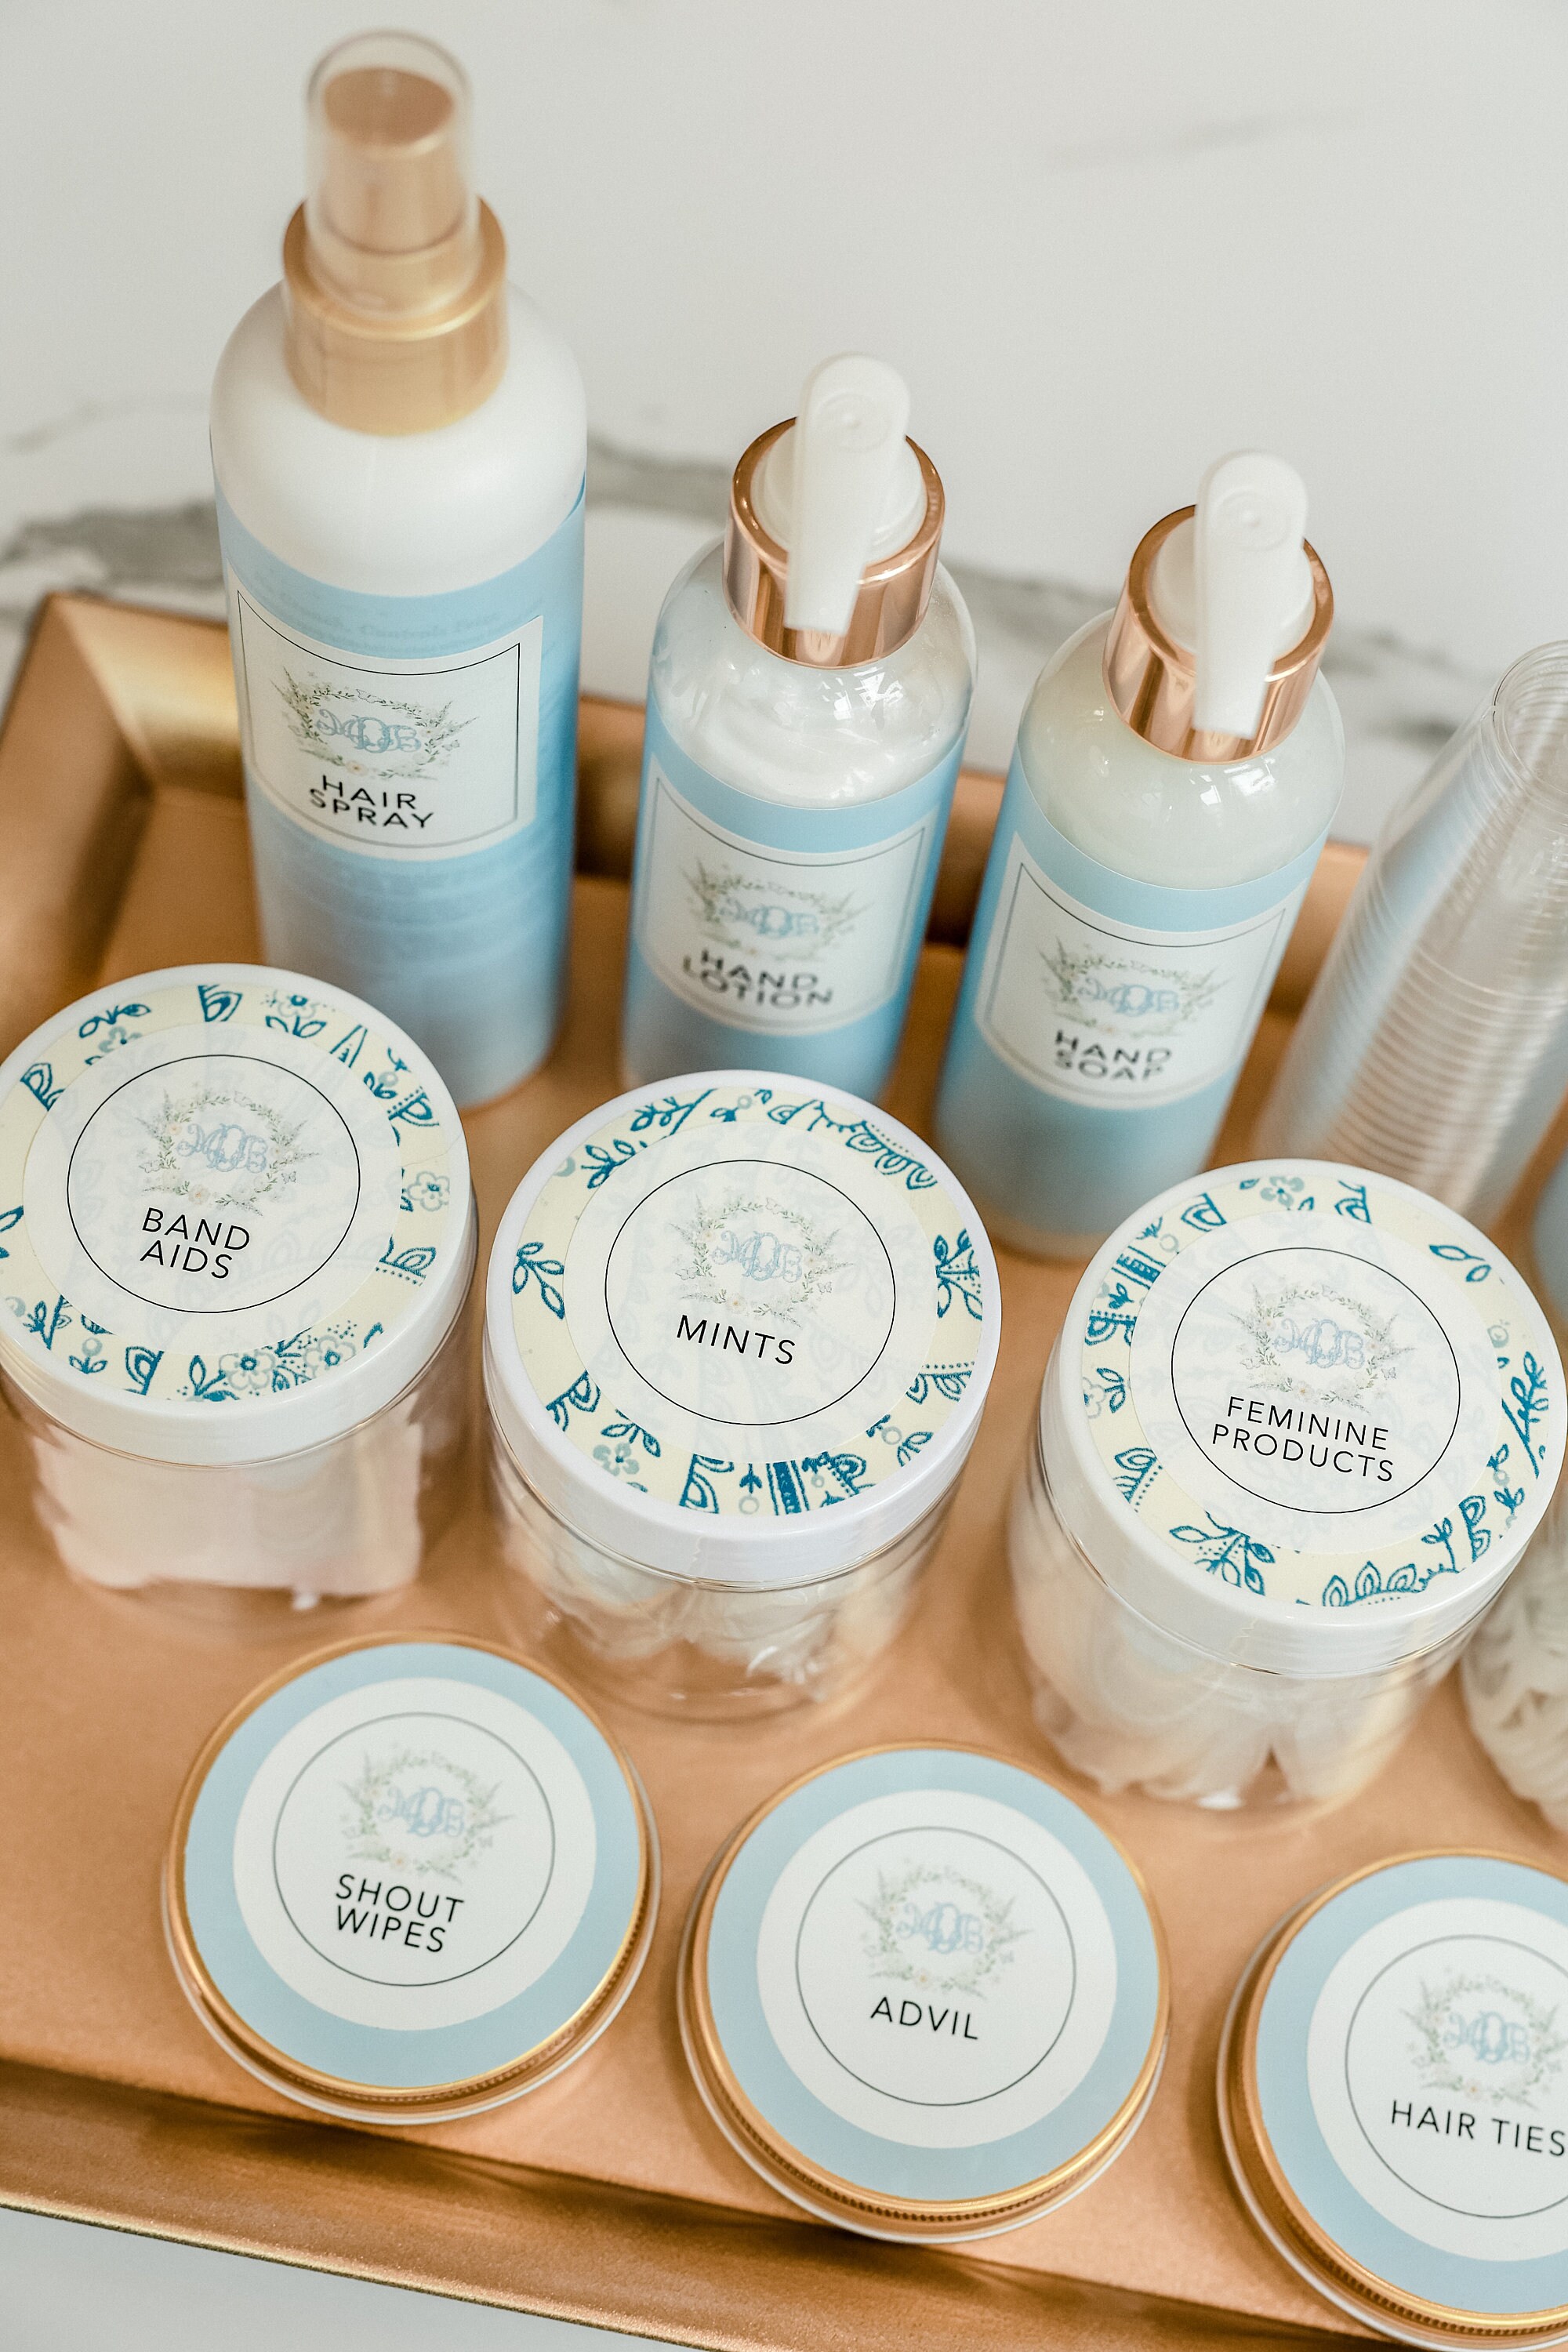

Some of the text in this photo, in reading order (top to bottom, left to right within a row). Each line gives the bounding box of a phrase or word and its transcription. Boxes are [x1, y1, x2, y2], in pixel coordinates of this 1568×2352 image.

[309, 788, 434, 829] SPRAY
[321, 774, 416, 810] HAIR
[682, 955, 833, 1010] LOTION
[701, 949, 818, 991] HAND
[1055, 1030, 1173, 1065] HAND
[1055, 1049, 1163, 1081] SOAP
[141, 1207, 250, 1250] BAND
[139, 1240, 233, 1279] AIDS
[677, 1314, 796, 1365] MINTS
[1227, 1396, 1388, 1450] FEMININE
[1212, 1423, 1394, 1482] PRODUCTS
[336, 1874, 465, 1922] SHOUT
[337, 1904, 446, 1953] WIPES
[869, 1996, 979, 2040] ADVIL
[1392, 2100, 1565, 2157] HAIR TIES
